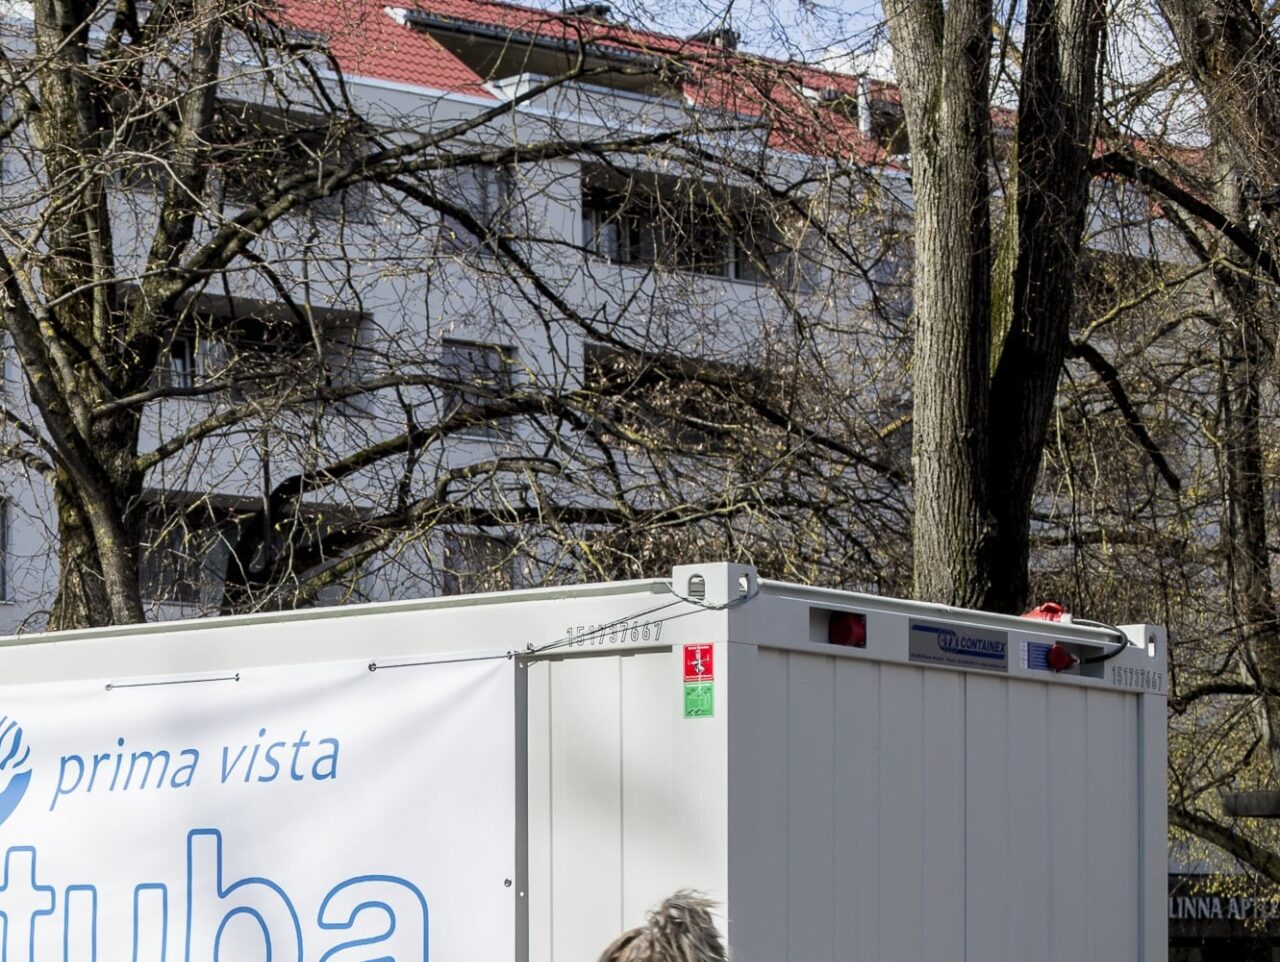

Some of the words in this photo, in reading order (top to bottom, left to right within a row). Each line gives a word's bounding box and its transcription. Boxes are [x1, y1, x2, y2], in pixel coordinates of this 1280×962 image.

[960, 637, 1006, 653] CONTAINEX
[49, 736, 201, 811] prima
[219, 727, 340, 784] vista
[1169, 897, 1222, 919] LINNA
